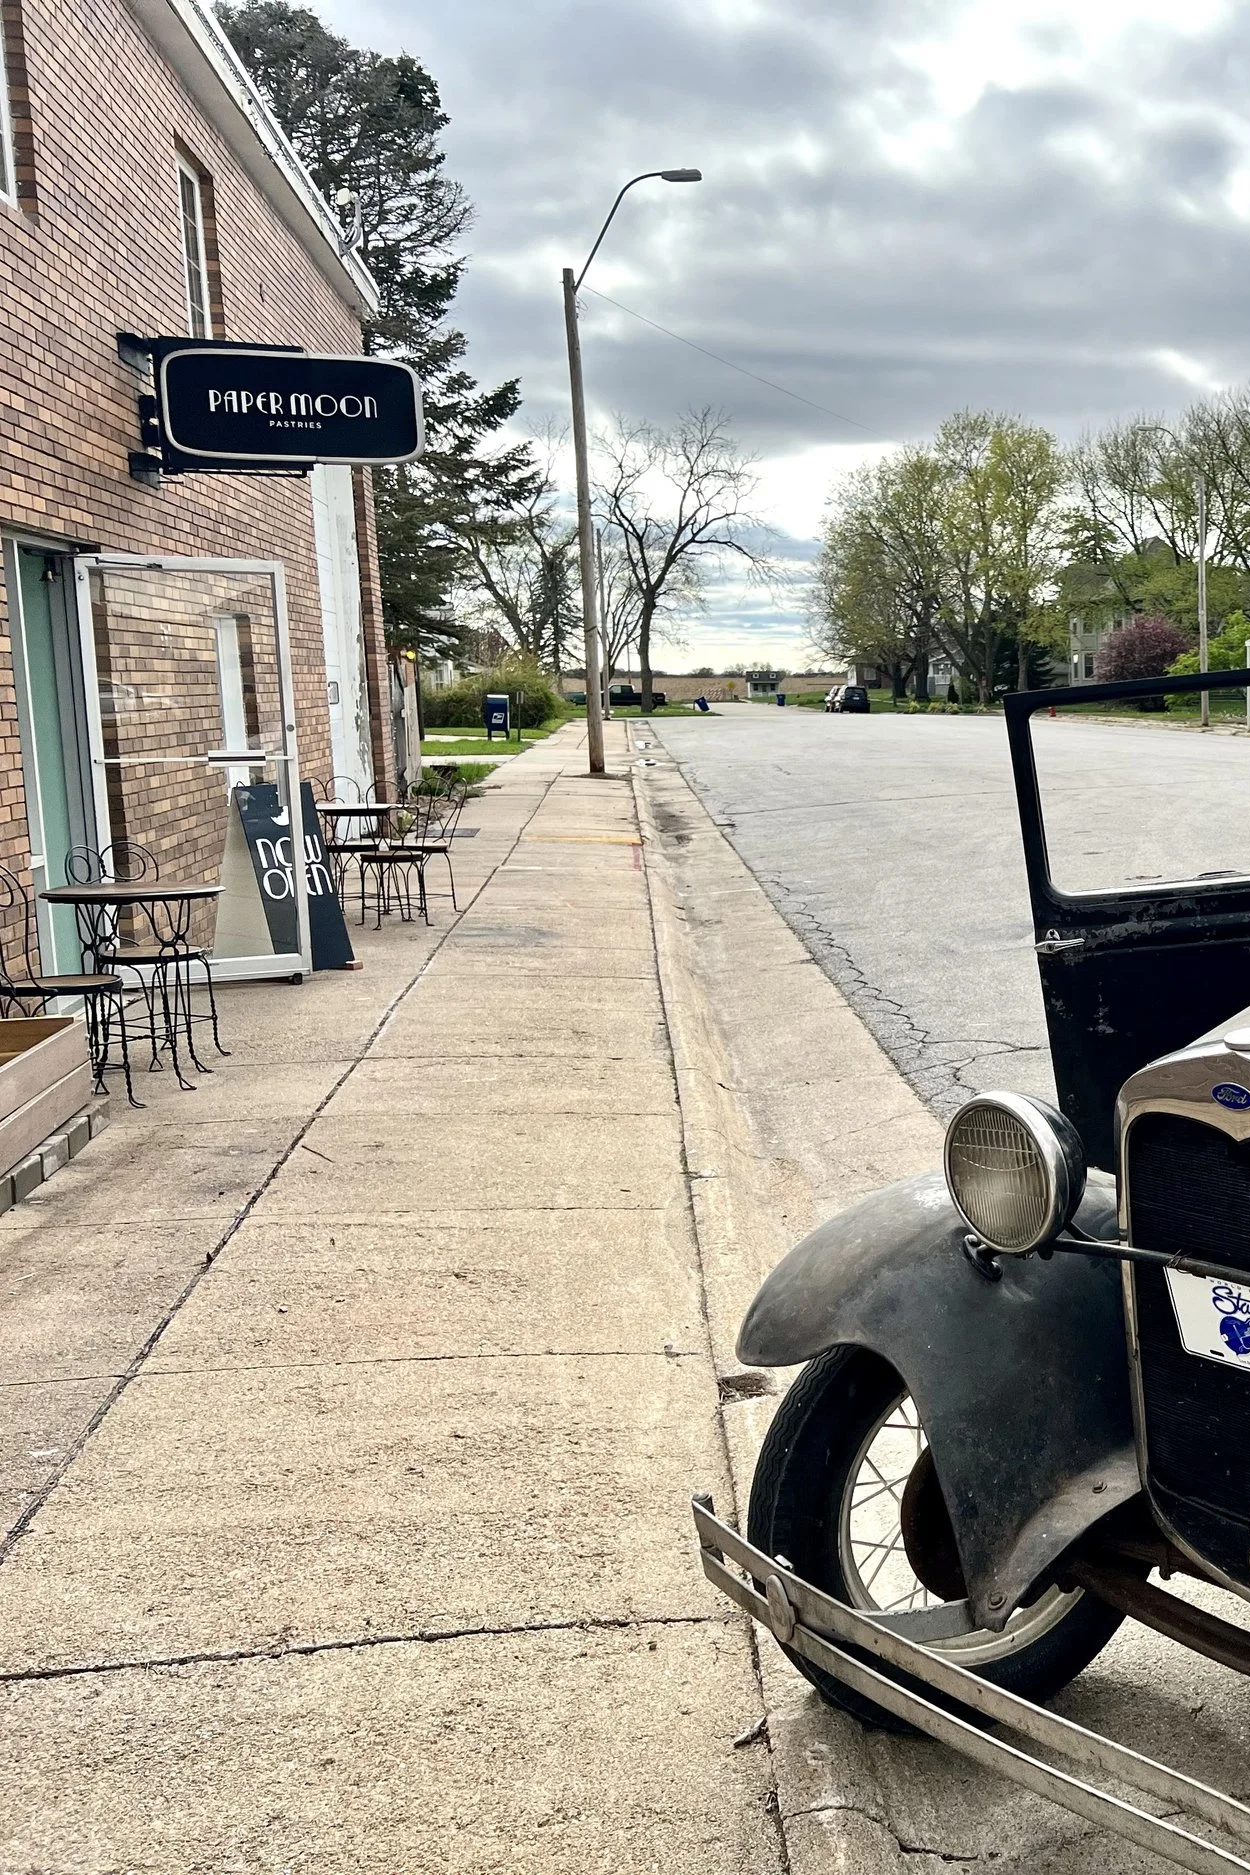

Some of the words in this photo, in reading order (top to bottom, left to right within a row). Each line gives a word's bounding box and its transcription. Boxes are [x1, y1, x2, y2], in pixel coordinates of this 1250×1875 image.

[208, 389, 284, 415] PAPER
[289, 393, 378, 419] MOON
[269, 420, 322, 429] PASTRIES
[1216, 1086, 1248, 1105] Ford
